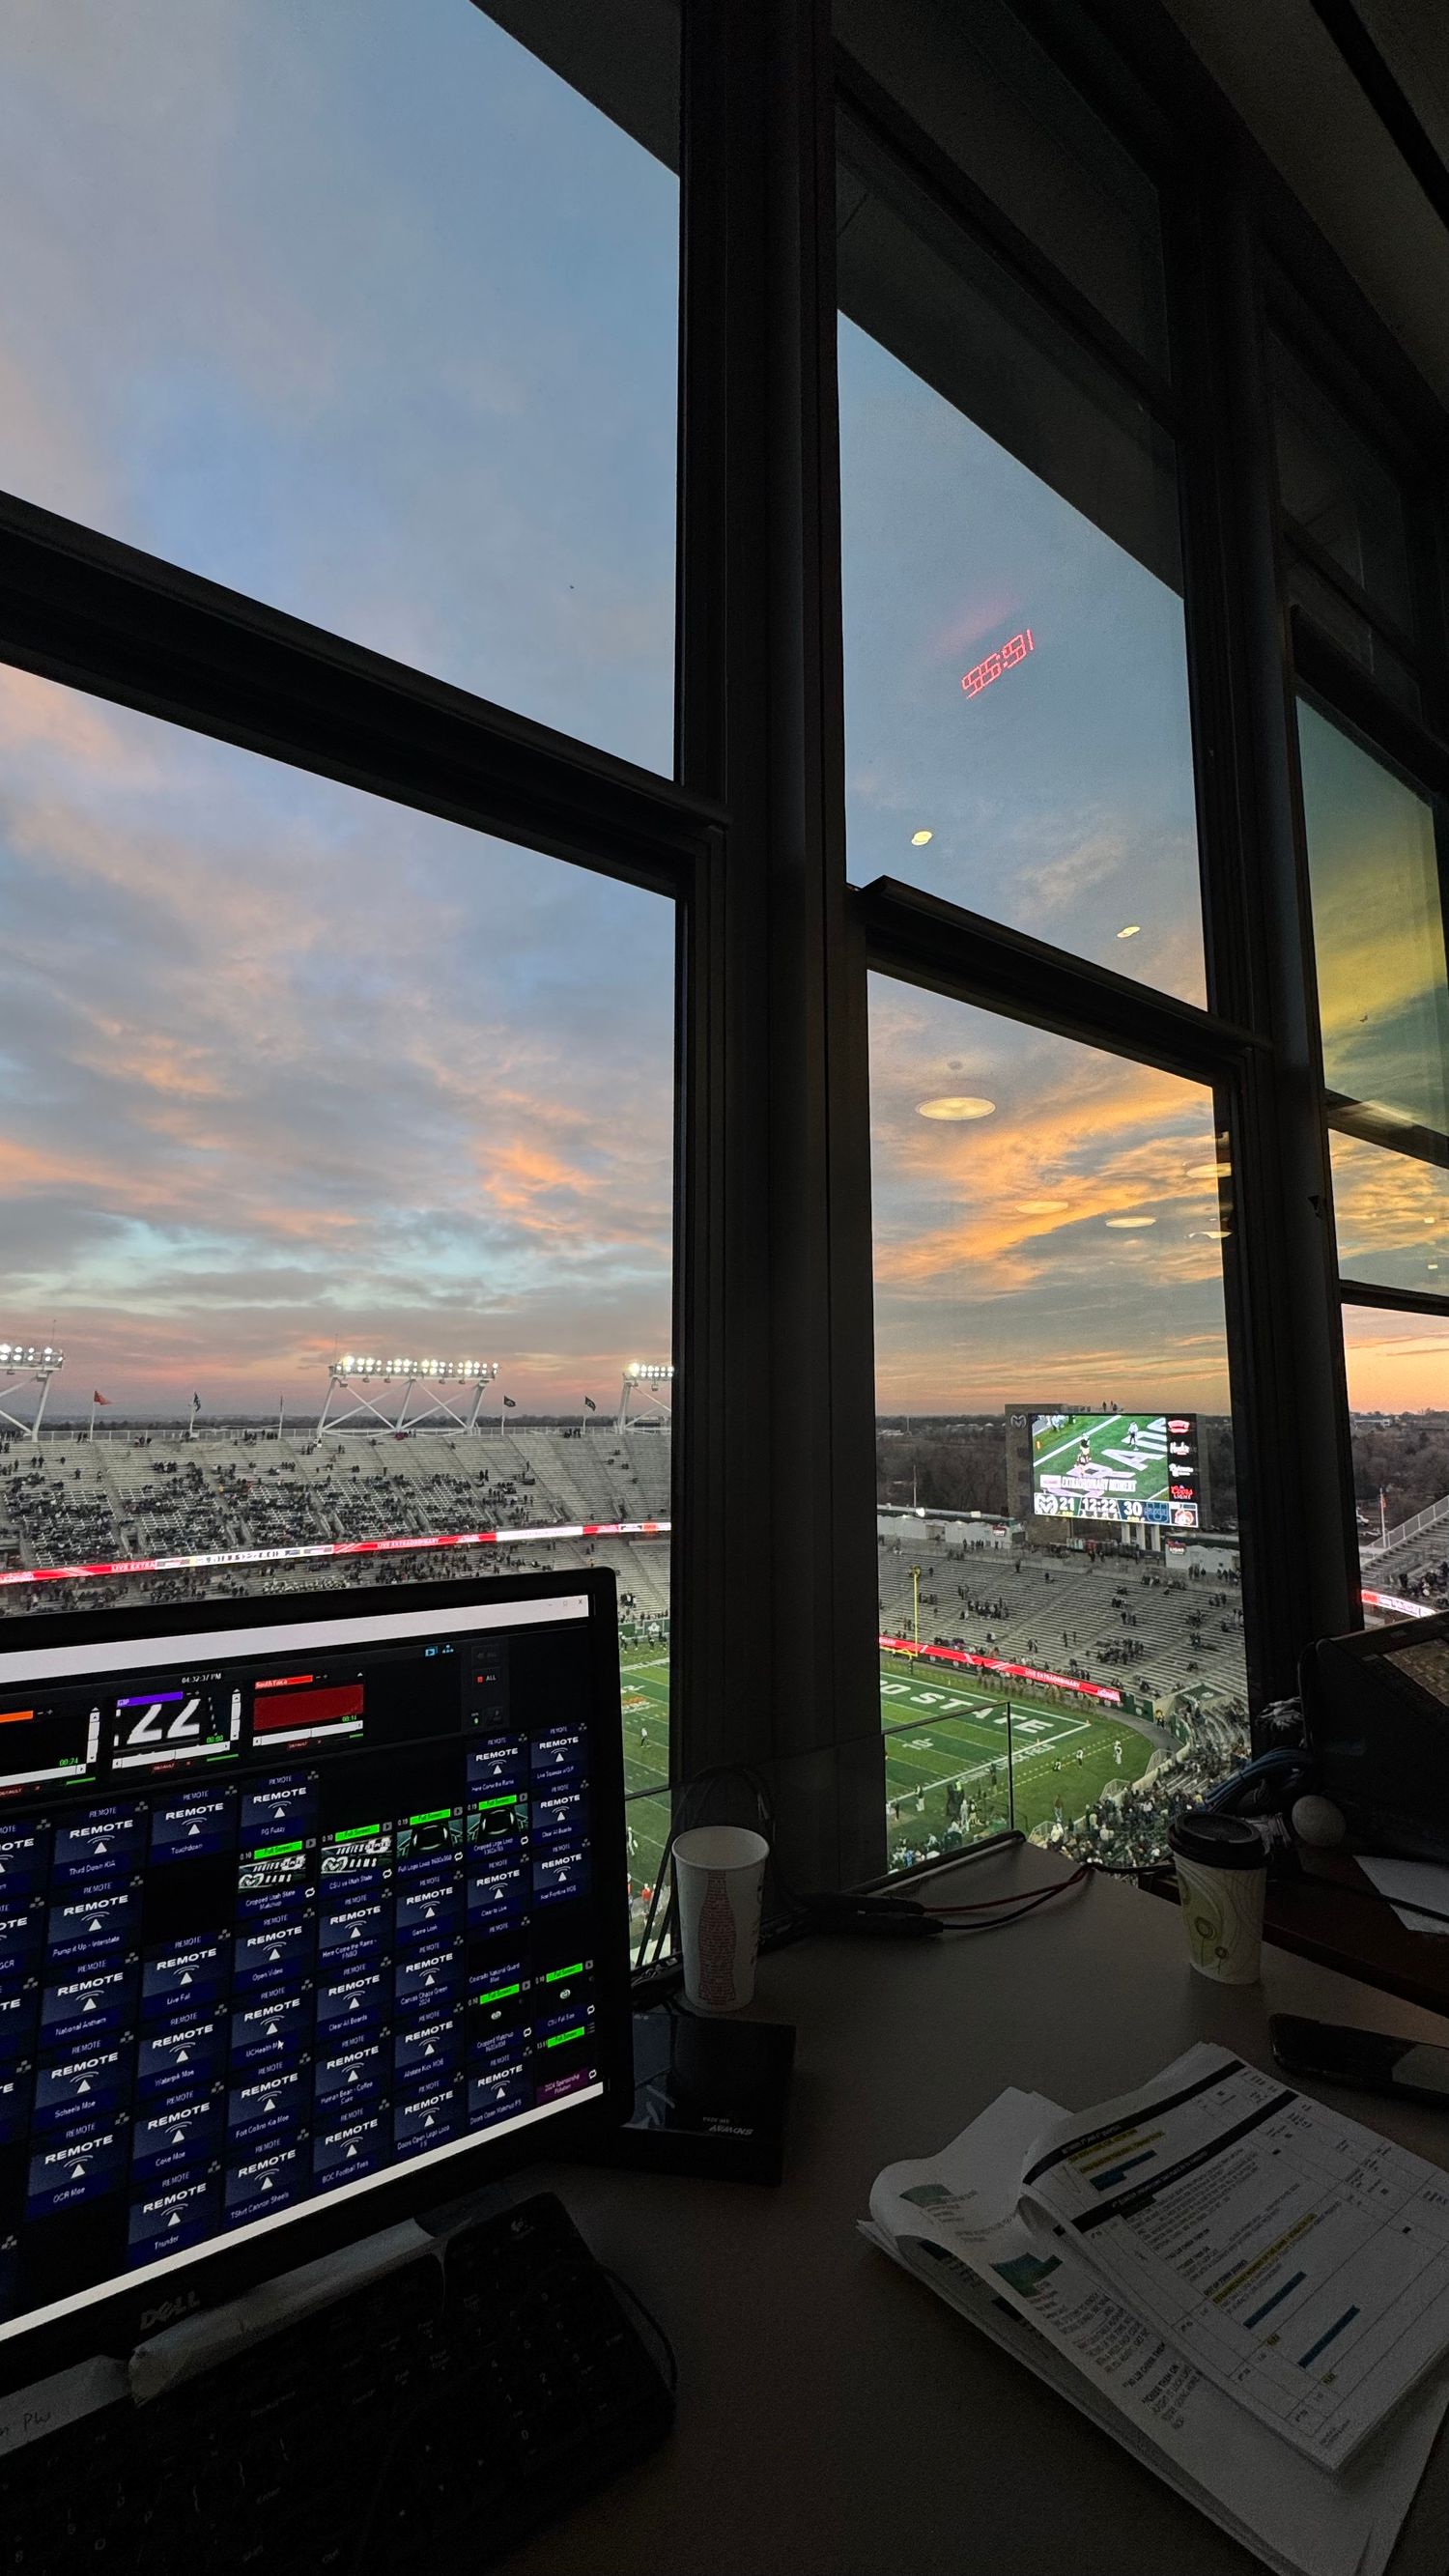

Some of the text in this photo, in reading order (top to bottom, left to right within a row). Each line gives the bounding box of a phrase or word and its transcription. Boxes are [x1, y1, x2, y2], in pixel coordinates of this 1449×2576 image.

[1059, 1497, 1075, 1512] 21
[1082, 1498, 1118, 1513] 12:22
[1124, 1501, 1143, 1515] 30
[112, 1564, 128, 1572] LIVE
[1037, 1671, 1081, 1688] EXTRAORDINARY
[910, 1692, 1054, 1734] STATE
[539, 1737, 579, 1749] REMOTE
[475, 1748, 519, 1761] REMOTE
[253, 1787, 307, 1804] REMOTE
[541, 1795, 581, 1809] REMOTE
[165, 1802, 224, 1821] REMOTE
[70, 1820, 133, 1839] REMOTE
[542, 1854, 582, 1869] REMOTE
[477, 1870, 521, 1886] REMOTE
[64, 1895, 128, 1916] REMOTE
[406, 1887, 453, 1905] REMOTE
[330, 1906, 381, 1925] REMOTE
[247, 1926, 302, 1947] REMOTE
[156, 1948, 217, 1970] REMOTE
[406, 1953, 453, 1973] REMOTE
[57, 1972, 124, 1996] REMOTE
[328, 1974, 380, 1996] REMOTE
[243, 1997, 300, 2022] REMOTE
[153, 2024, 213, 2050] REMOTE
[406, 2021, 453, 2043] REMOTE
[51, 2052, 119, 2079] REMOTE
[327, 2046, 380, 2070] REMOTE
[242, 2073, 298, 2099] REMOTE
[477, 2065, 523, 2087] REMOTE
[54, 2100, 96, 2118] Scheels Moe
[404, 2090, 454, 2115] REMOTE
[148, 2102, 211, 2130] REMOTE
[325, 2119, 379, 2145] REMOTE
[44, 2135, 113, 2165] REMOTE
[238, 2149, 297, 2178] REMOTE
[143, 2183, 207, 2213] REMOTE
[155, 2235, 180, 2250] Thunder
[139, 2290, 200, 2331] DELL
